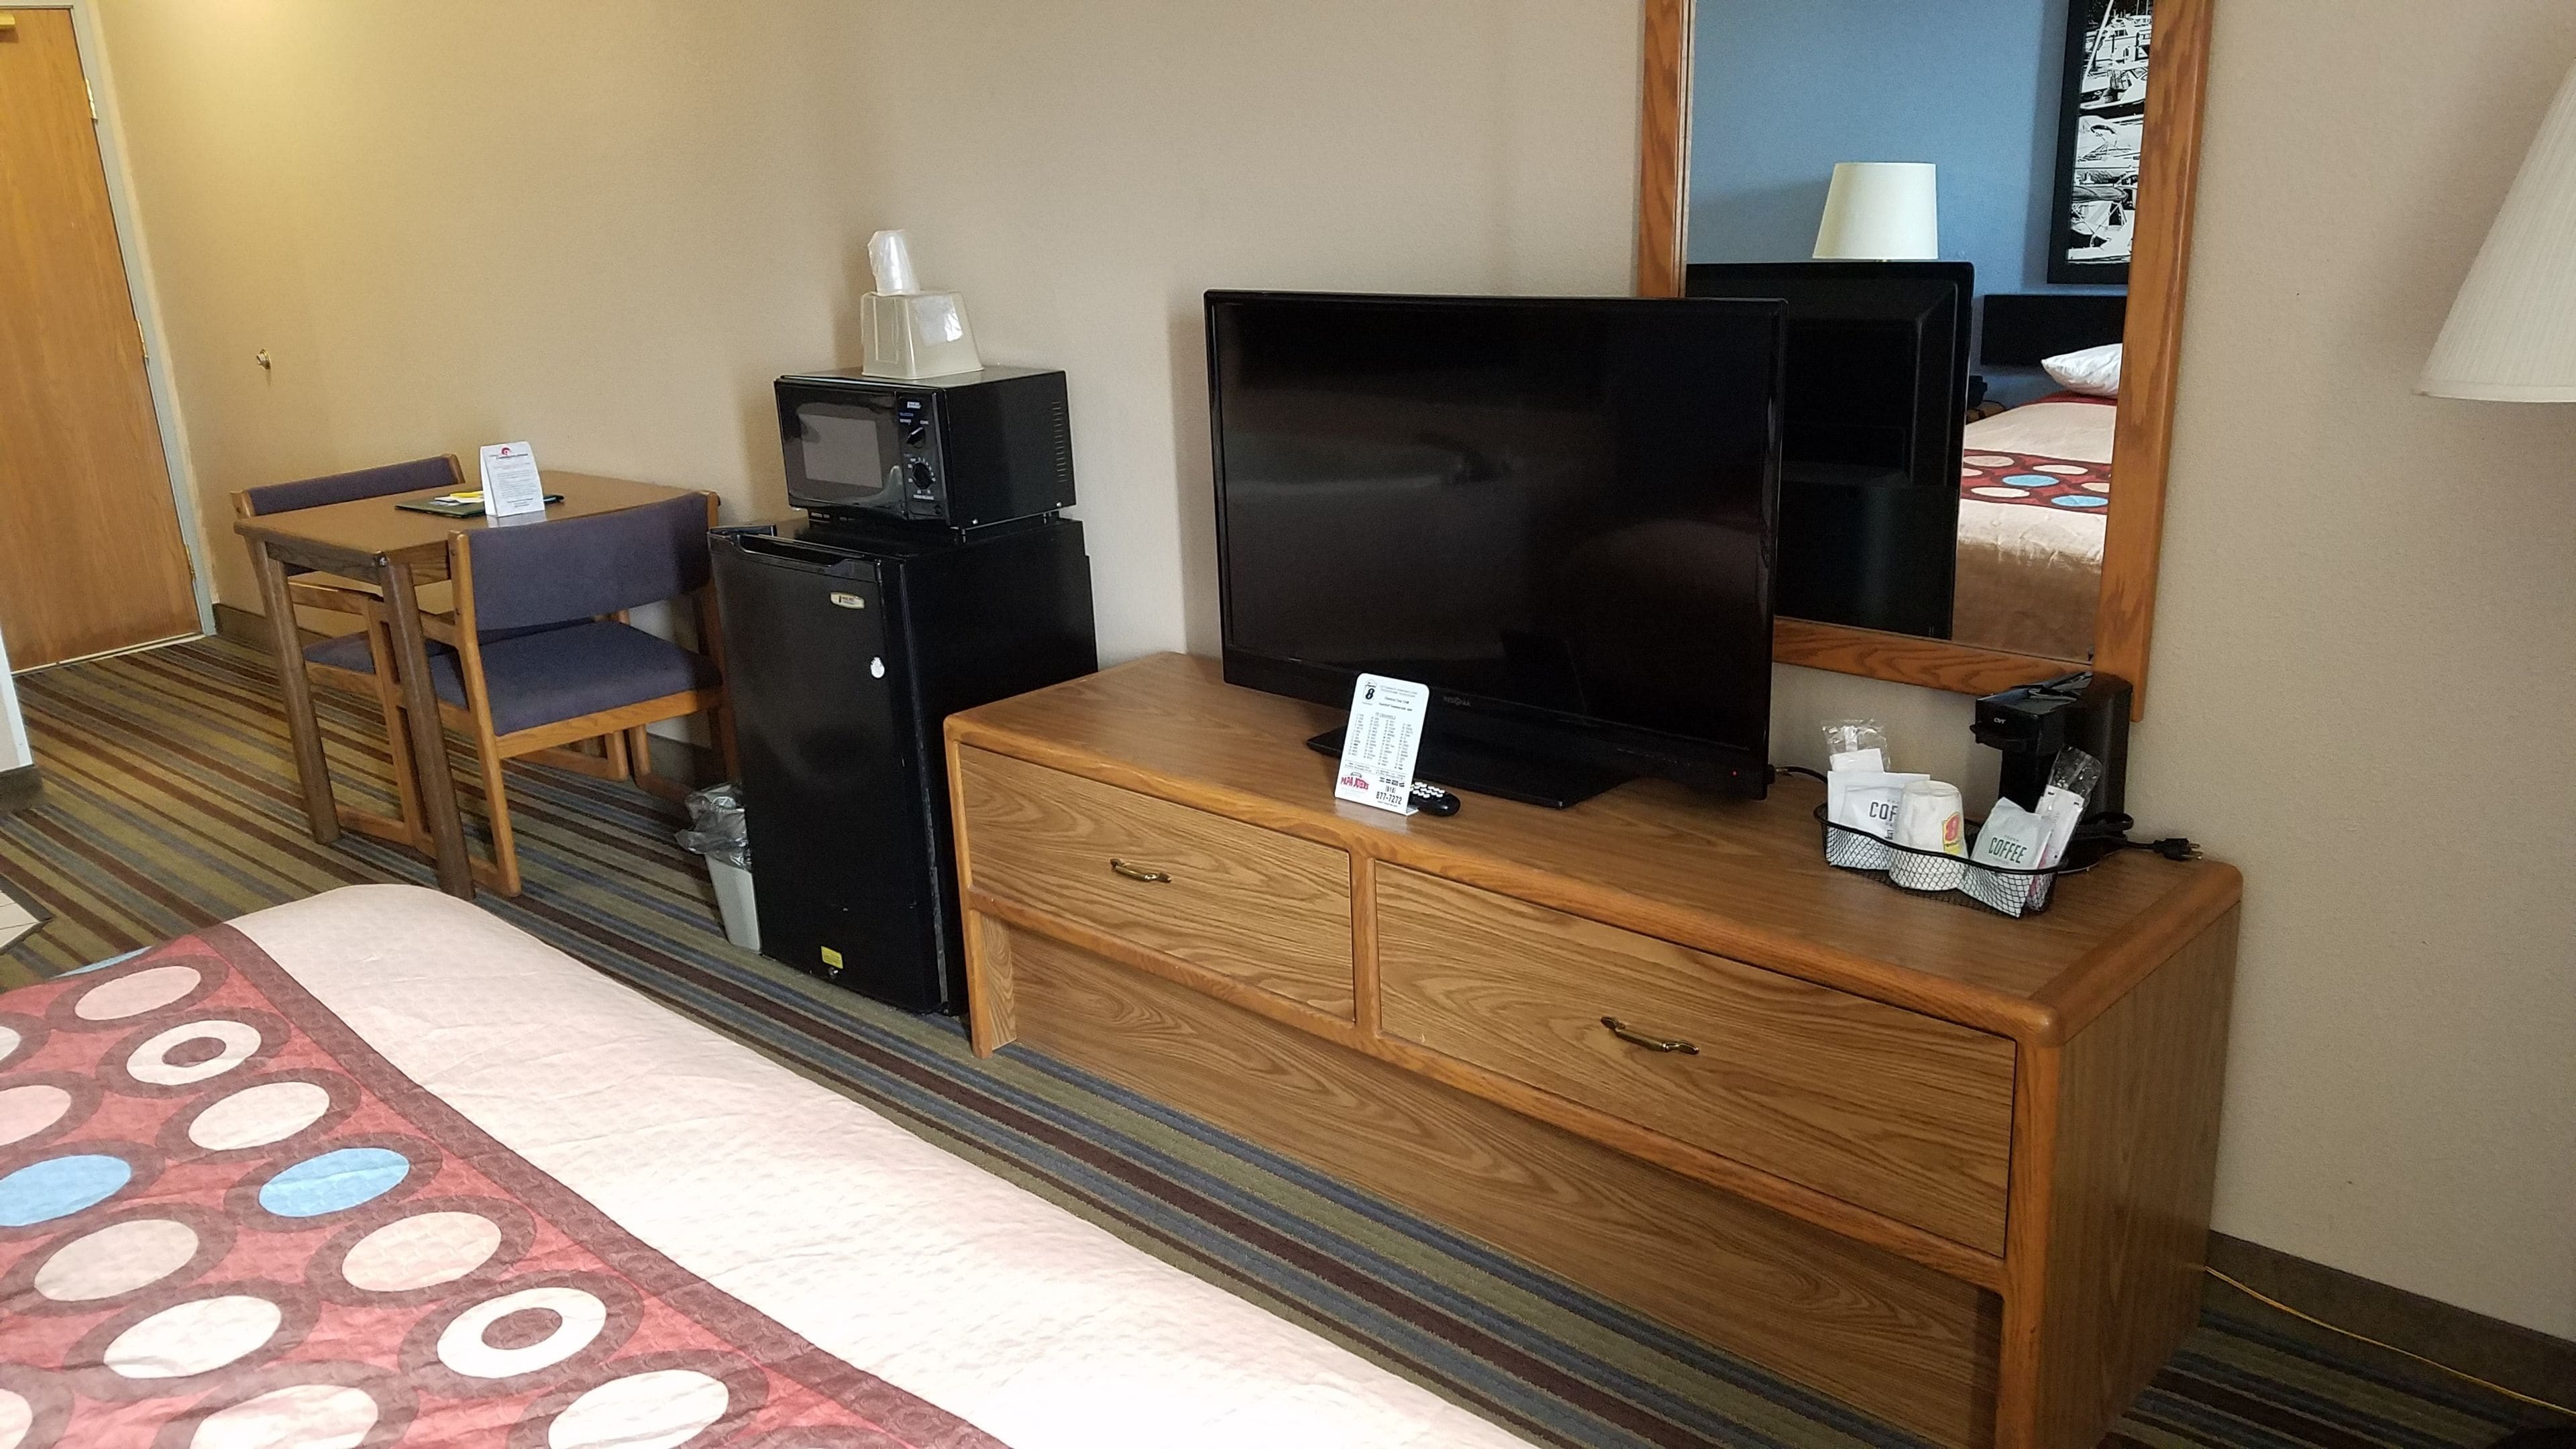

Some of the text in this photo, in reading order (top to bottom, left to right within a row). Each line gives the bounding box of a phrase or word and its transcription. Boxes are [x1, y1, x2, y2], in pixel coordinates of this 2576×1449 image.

[1365, 688, 1375, 700] 8
[1869, 801, 1898, 822] COF
[1988, 837, 2027, 864] COFFEE
